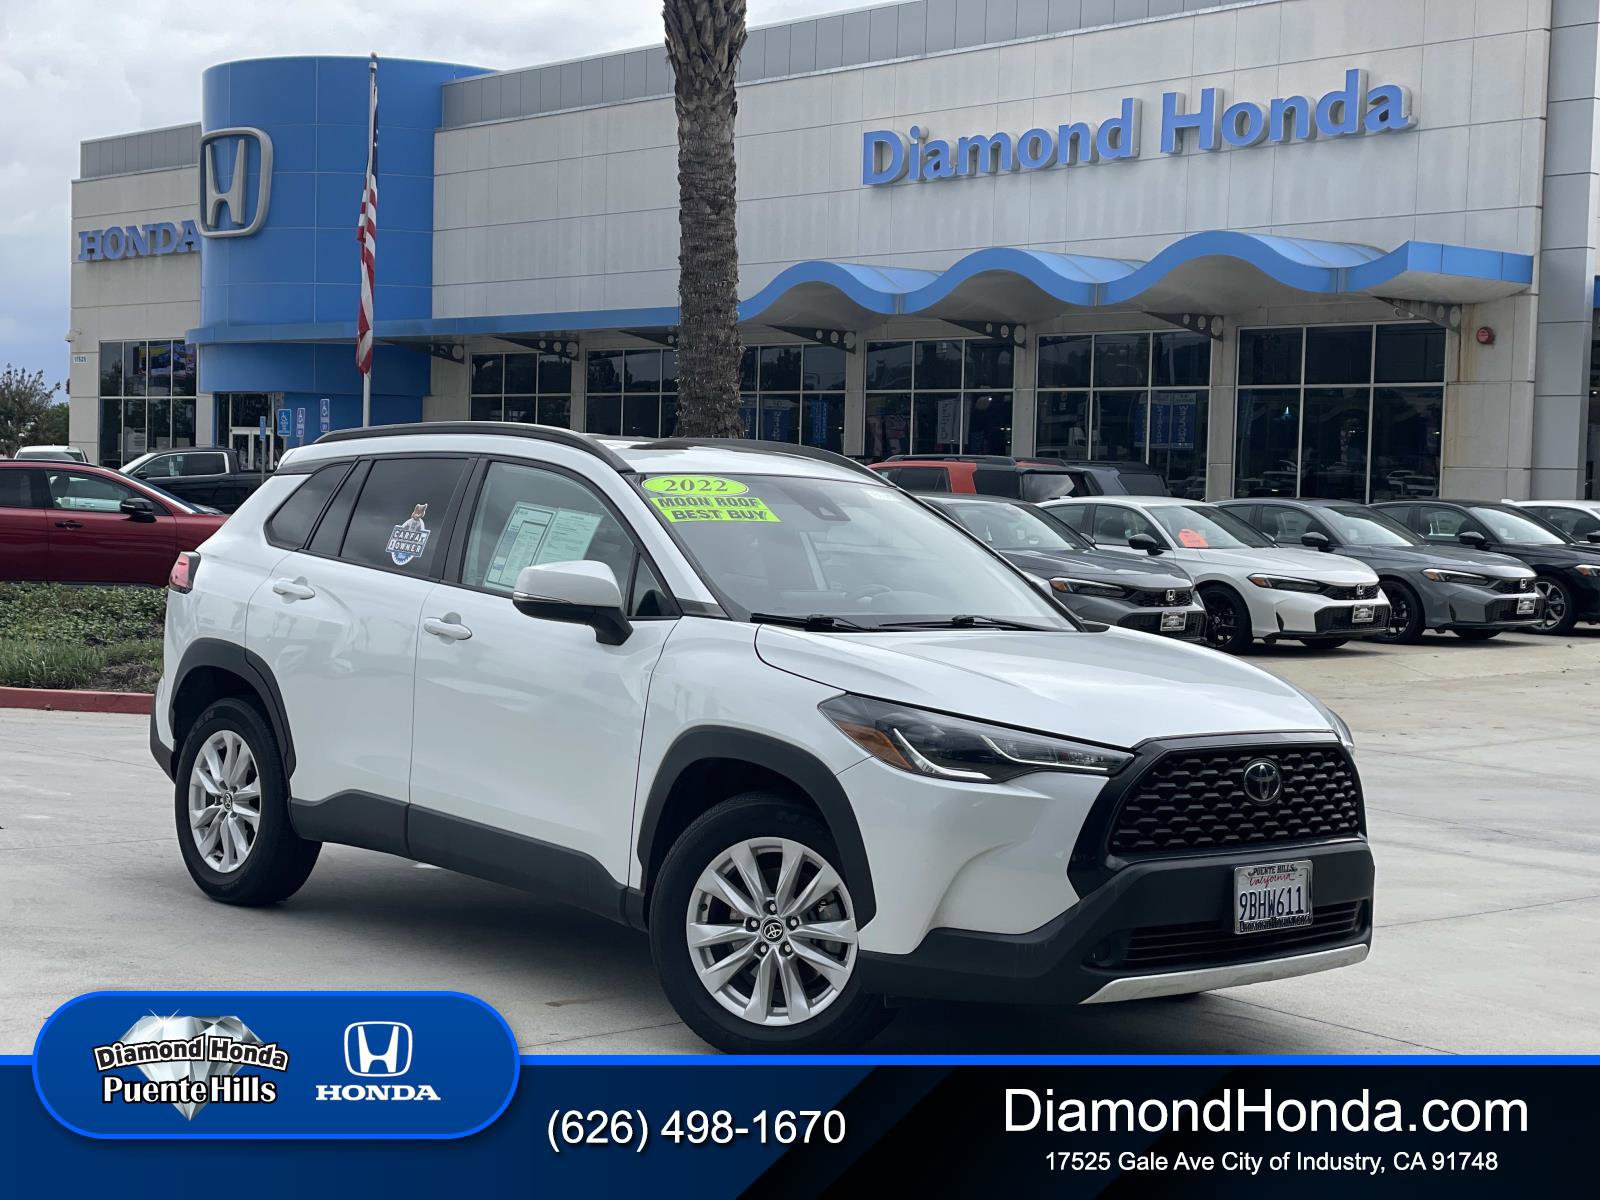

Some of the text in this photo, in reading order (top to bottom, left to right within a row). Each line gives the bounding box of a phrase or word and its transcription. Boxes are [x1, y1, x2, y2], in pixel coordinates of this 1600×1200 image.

[862, 69, 1417, 186] Diamond Honda
[78, 218, 200, 261] HONDA
[663, 479, 729, 492] 2022
[658, 497, 760, 507] MOON ROOF
[671, 510, 767, 519] BEST BUY
[1249, 872, 1295, 888] California
[1239, 886, 1304, 920] 9BHW611
